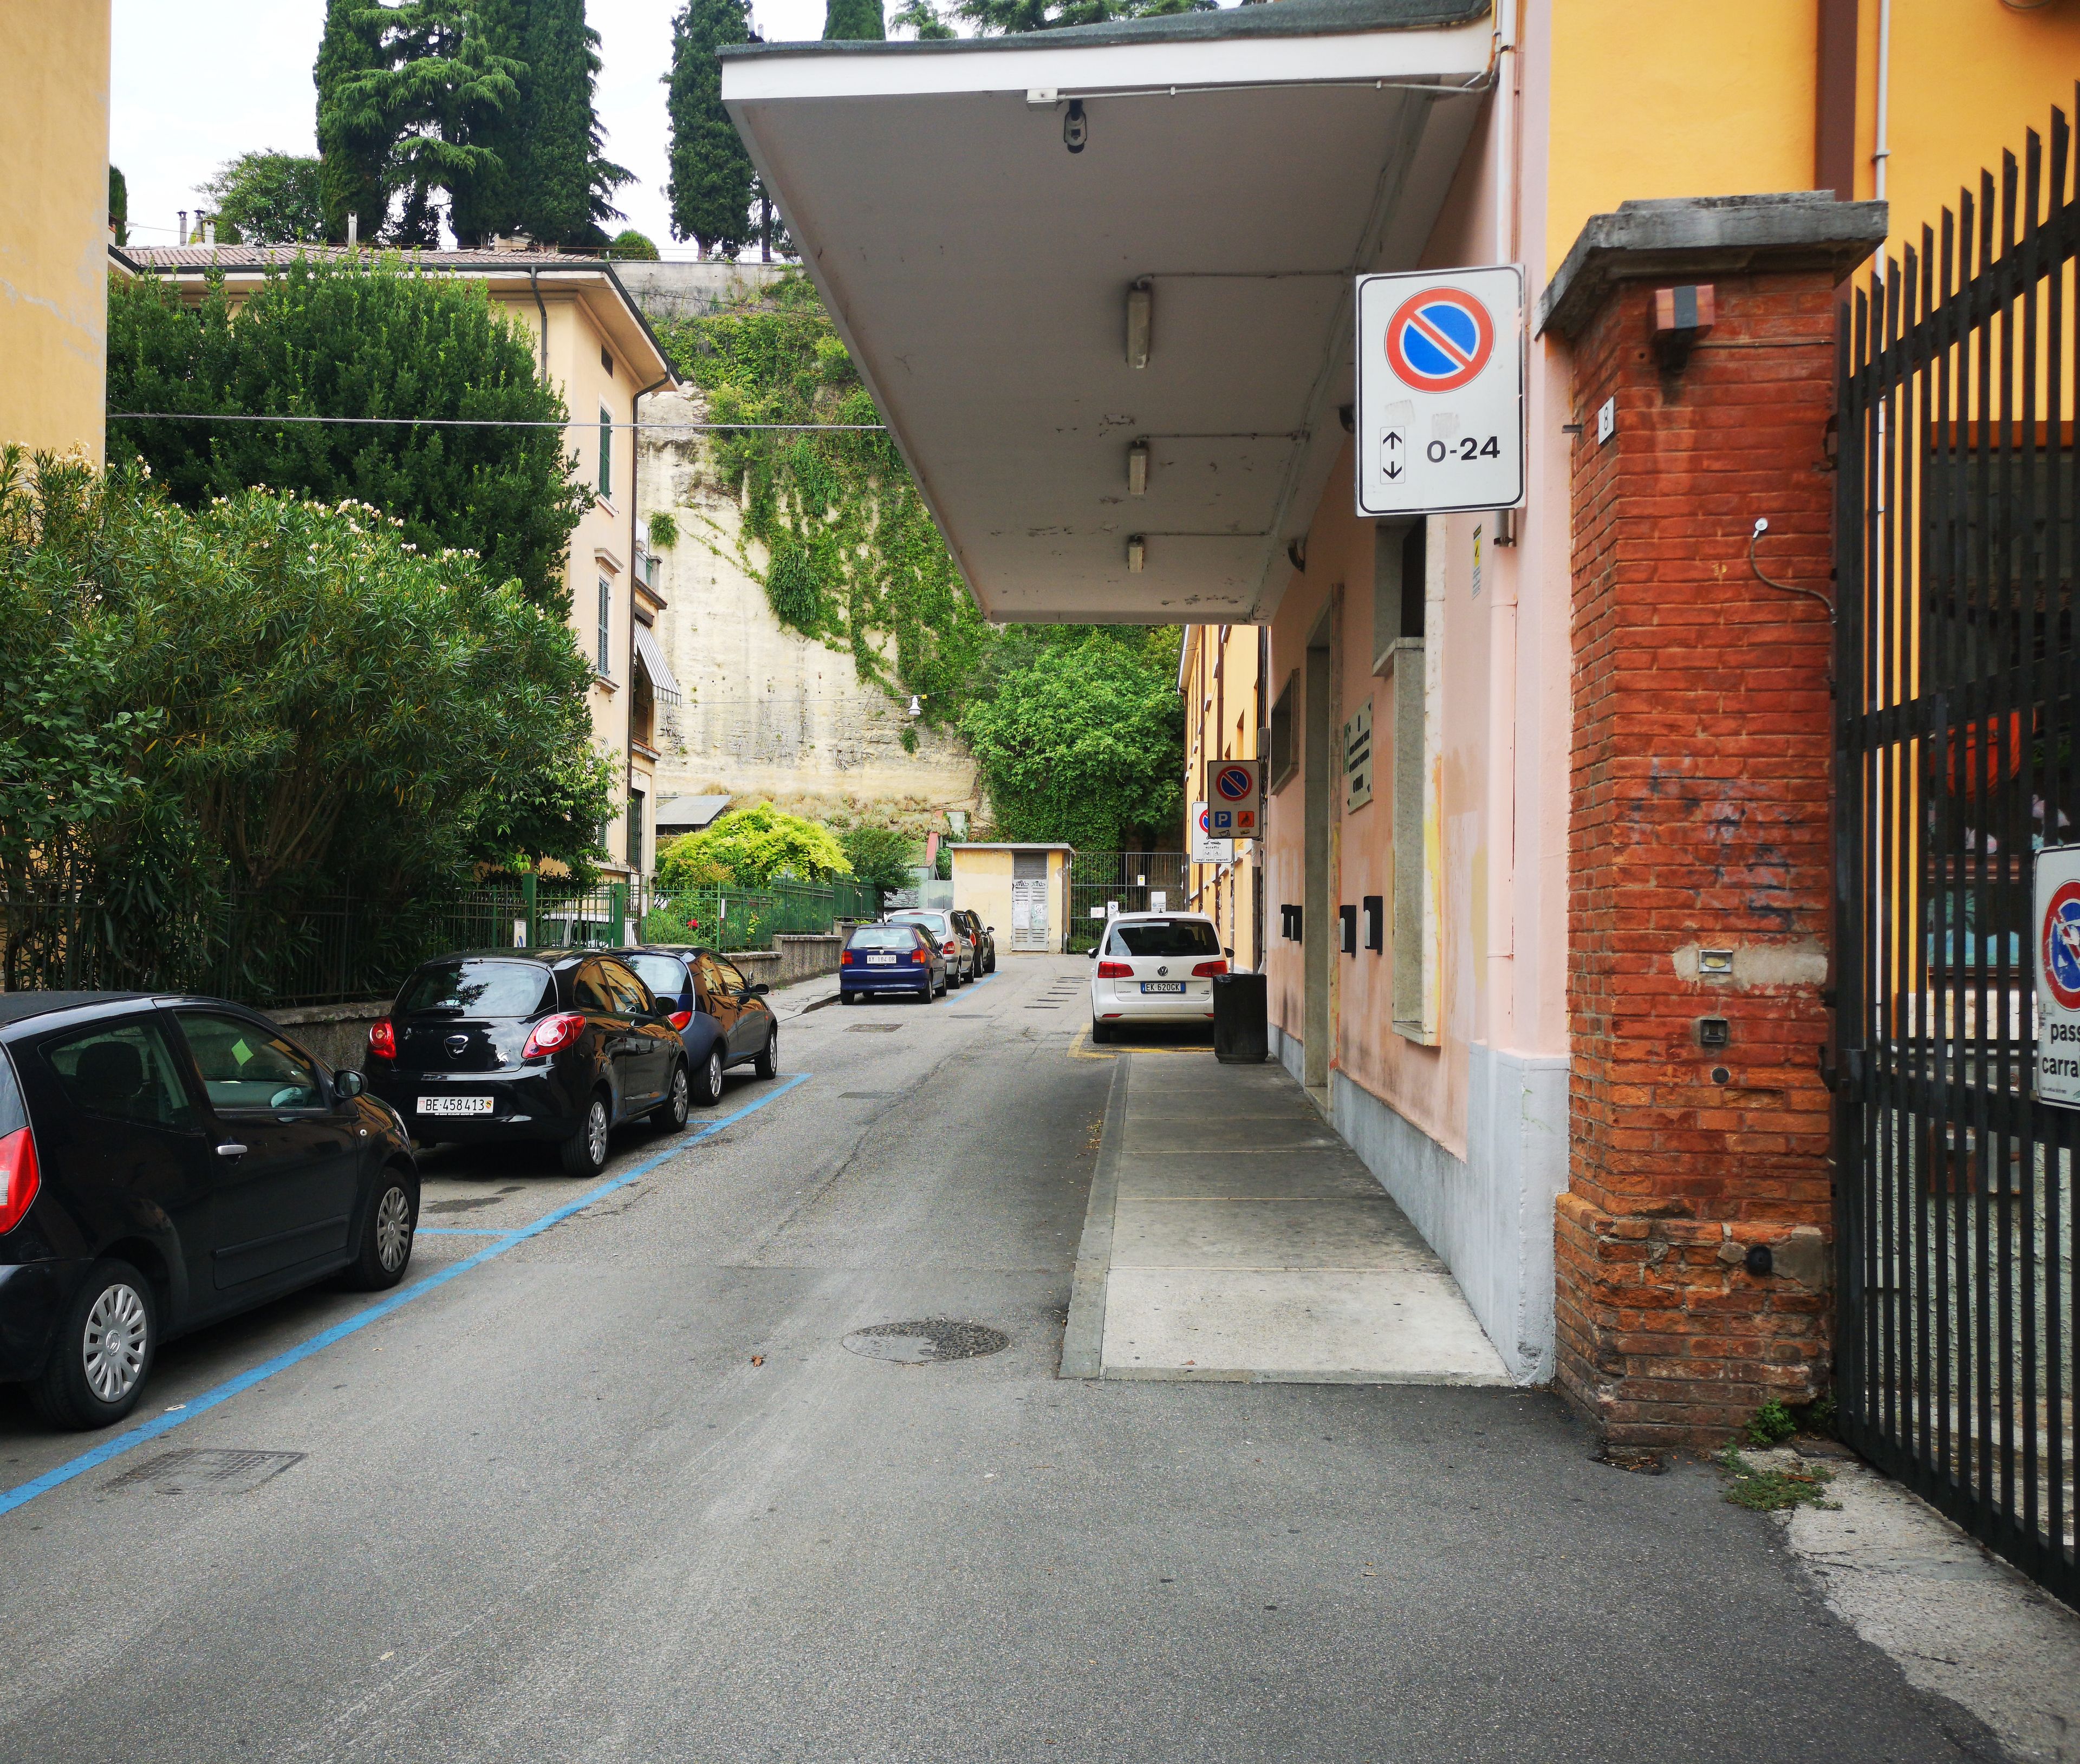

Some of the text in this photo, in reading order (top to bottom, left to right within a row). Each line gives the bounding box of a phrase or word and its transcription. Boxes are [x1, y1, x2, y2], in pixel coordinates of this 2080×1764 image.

[1604, 406, 1608, 431] 8
[1427, 436, 1500, 463] 0-24
[2042, 1057, 2080, 1078] carra
